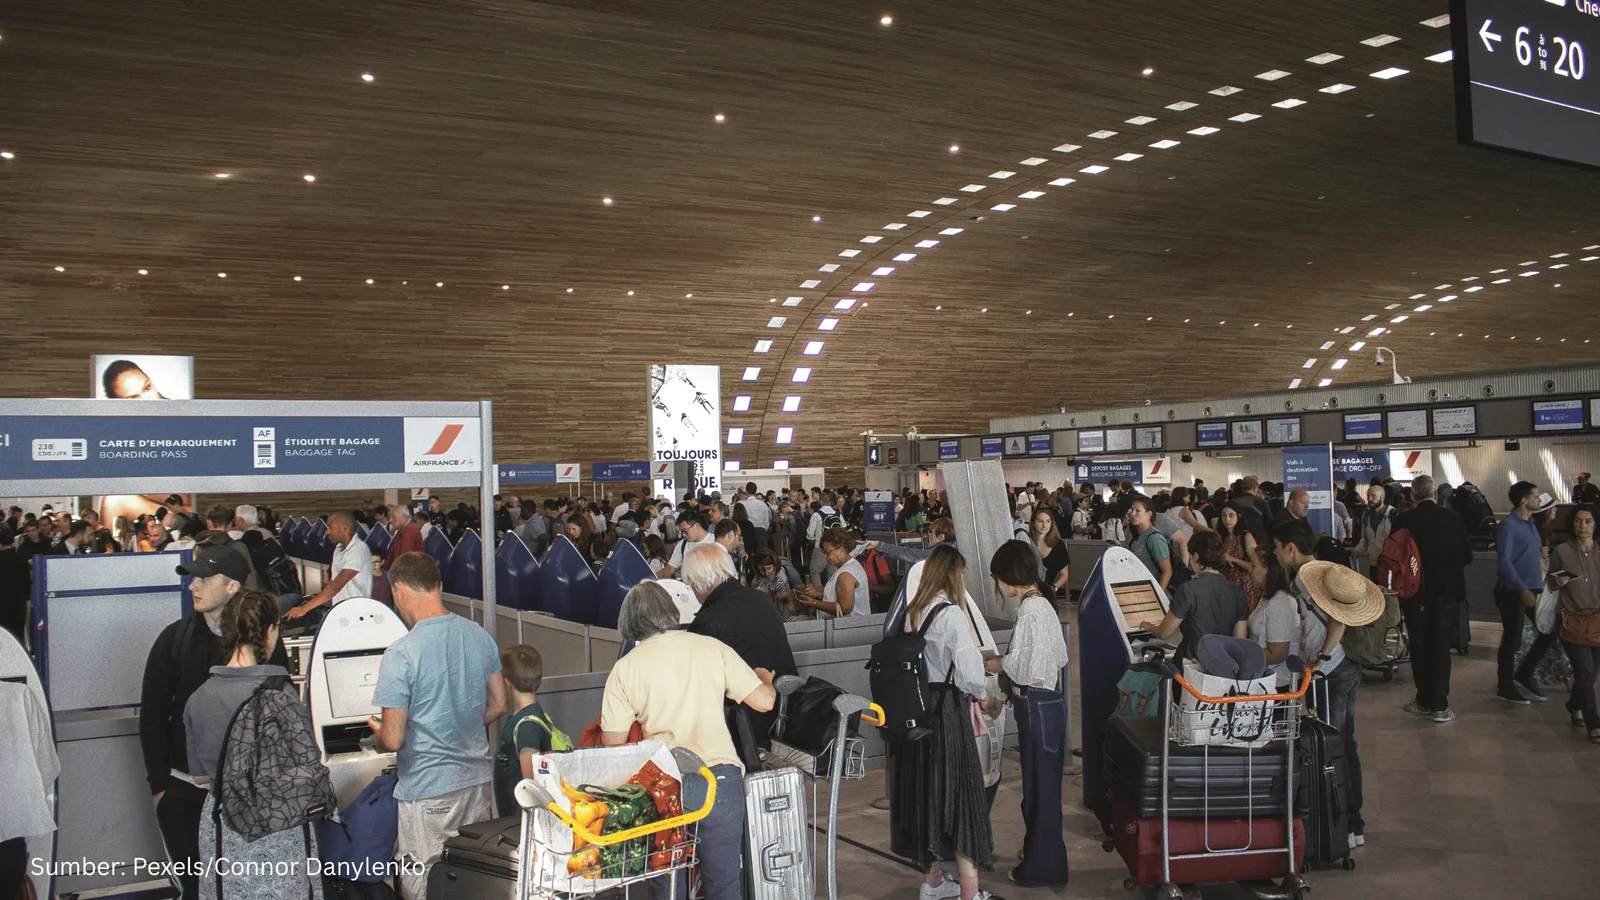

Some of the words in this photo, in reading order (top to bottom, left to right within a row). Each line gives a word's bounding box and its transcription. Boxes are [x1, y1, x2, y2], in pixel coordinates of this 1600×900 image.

[1575, 0, 1600, 17] Che
[1515, 26, 1531, 66] 6
[1553, 36, 1584, 80] 20
[1538, 46, 1547, 58] to
[99, 440, 136, 448] CARTE
[285, 437, 336, 446] ÉTIQUETTE
[99, 451, 158, 459] BOARDING
[161, 450, 188, 458] PASS
[337, 448, 356, 456] TAG
[656, 449, 718, 460] TOUJOURS
[870, 449, 877, 461] 4
